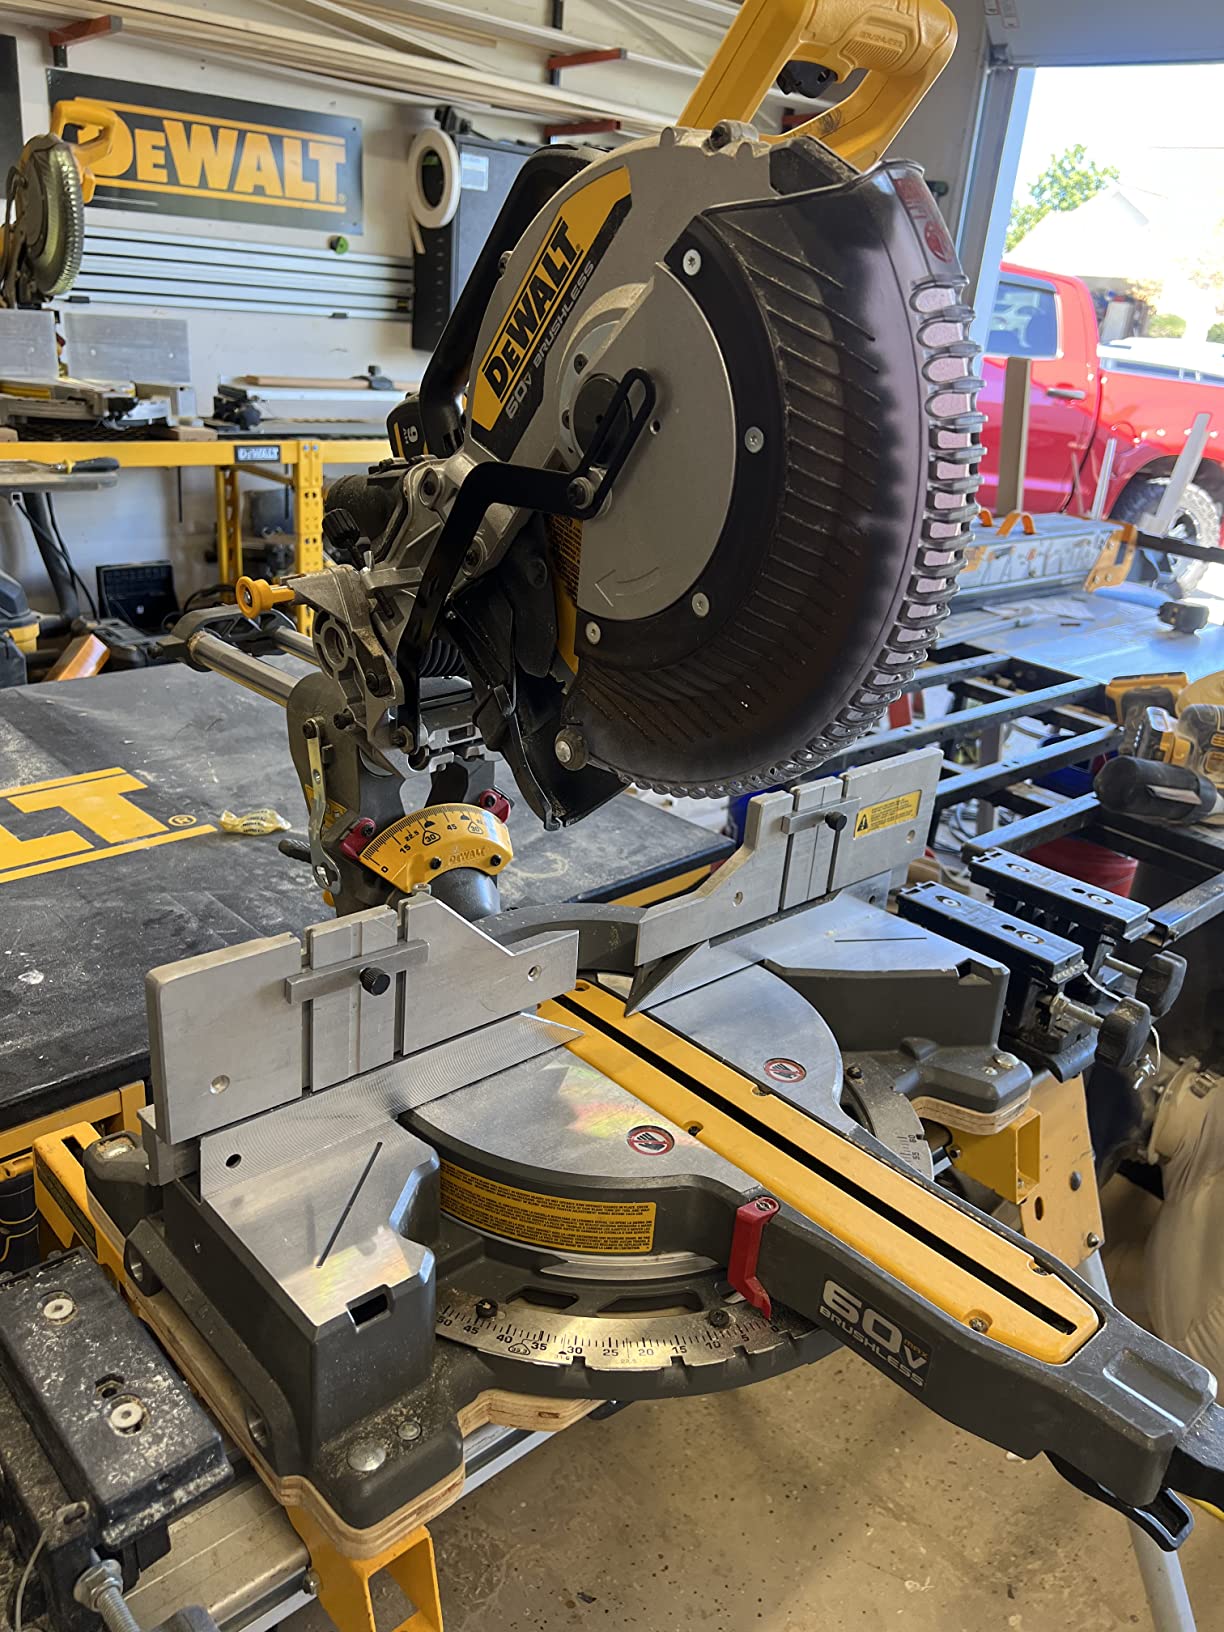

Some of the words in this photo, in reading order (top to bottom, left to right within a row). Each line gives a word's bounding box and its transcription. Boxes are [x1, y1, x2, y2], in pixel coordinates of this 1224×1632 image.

[482, 220, 579, 400] DEWALT
[533, 260, 595, 369] BRUSHLESS
[424, 833, 437, 843] 30
[446, 823, 457, 831] 45
[400, 844, 411, 854] 15
[380, 865, 389, 873] 0
[436, 1315, 453, 1327] 50
[462, 1325, 480, 1335] 45
[496, 1333, 513, 1344] 40
[530, 1341, 547, 1351] 35
[566, 1345, 583, 1355] 30
[602, 1348, 619, 1357] 25
[638, 1348, 654, 1356] 20
[671, 1345, 688, 1354] 15
[705, 1340, 721, 1350] 10
[741, 1334, 750, 1342] 5
[819, 1305, 925, 1387] BRUSHLESS
